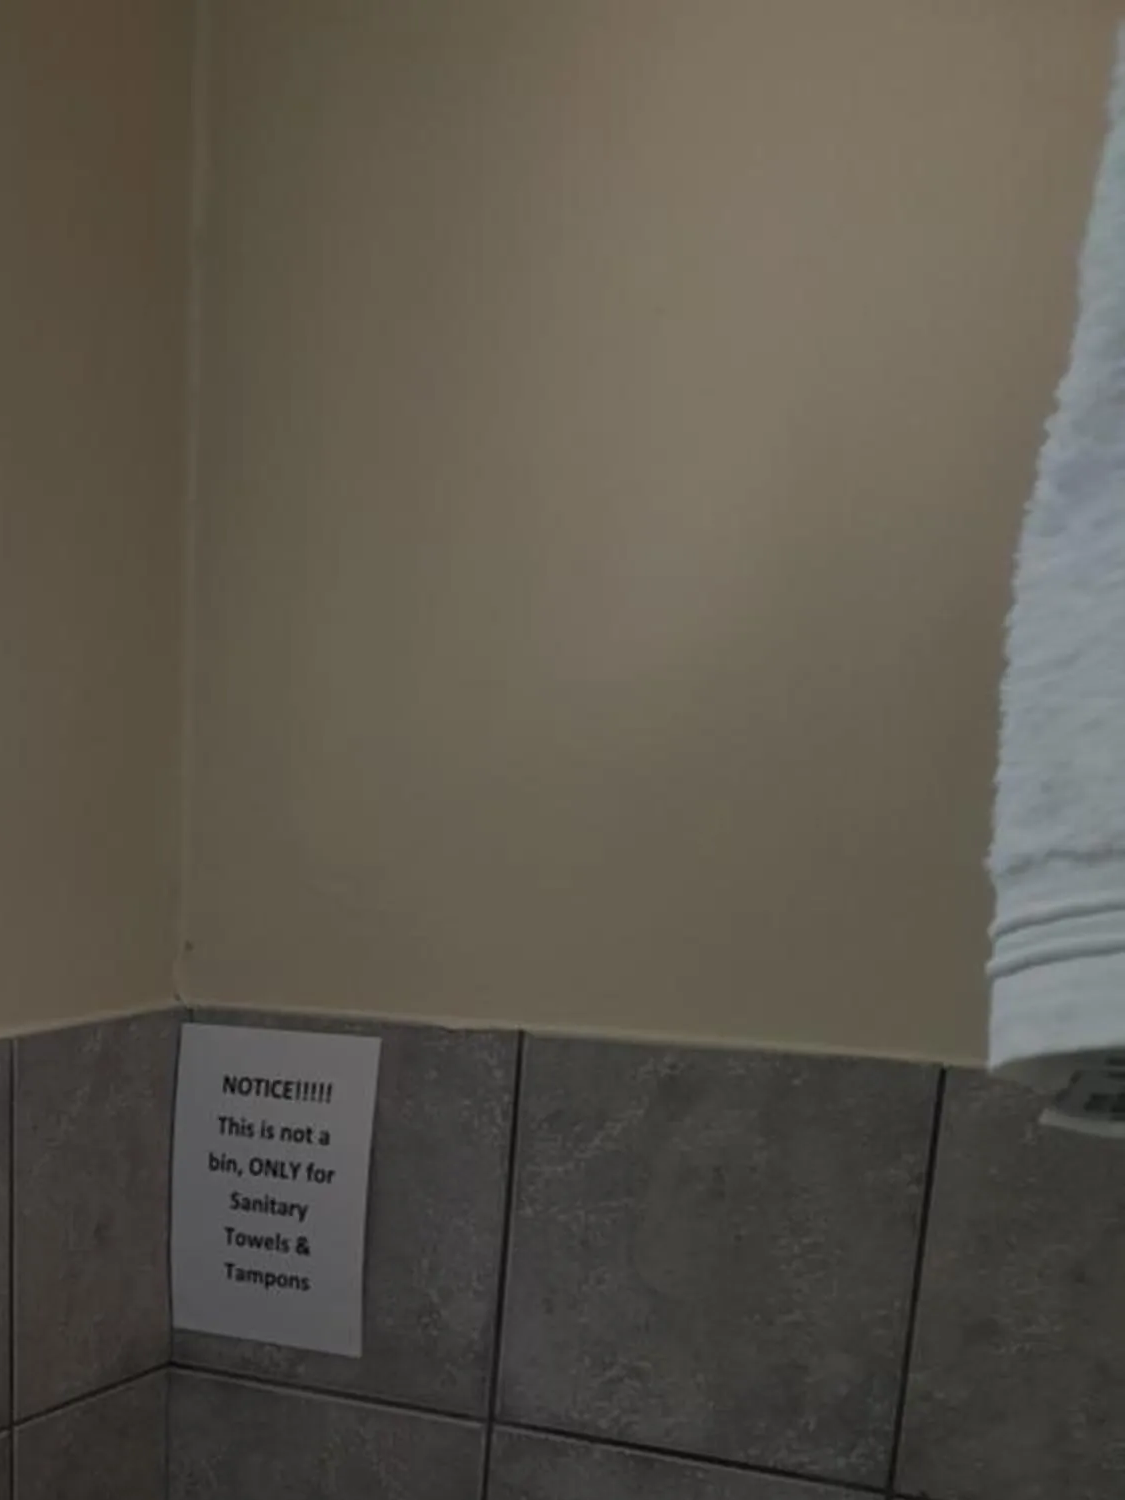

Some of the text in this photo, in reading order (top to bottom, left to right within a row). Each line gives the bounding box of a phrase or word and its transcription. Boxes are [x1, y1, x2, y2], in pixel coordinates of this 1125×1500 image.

[222, 1075, 333, 1103] NOTICE!!!!!
[218, 1116, 331, 1146] This is not a
[208, 1152, 335, 1184] bin, ONLY for
[229, 1191, 309, 1222] Sanitary
[224, 1226, 311, 1256] Towels &
[224, 1262, 311, 1291] Tampons
